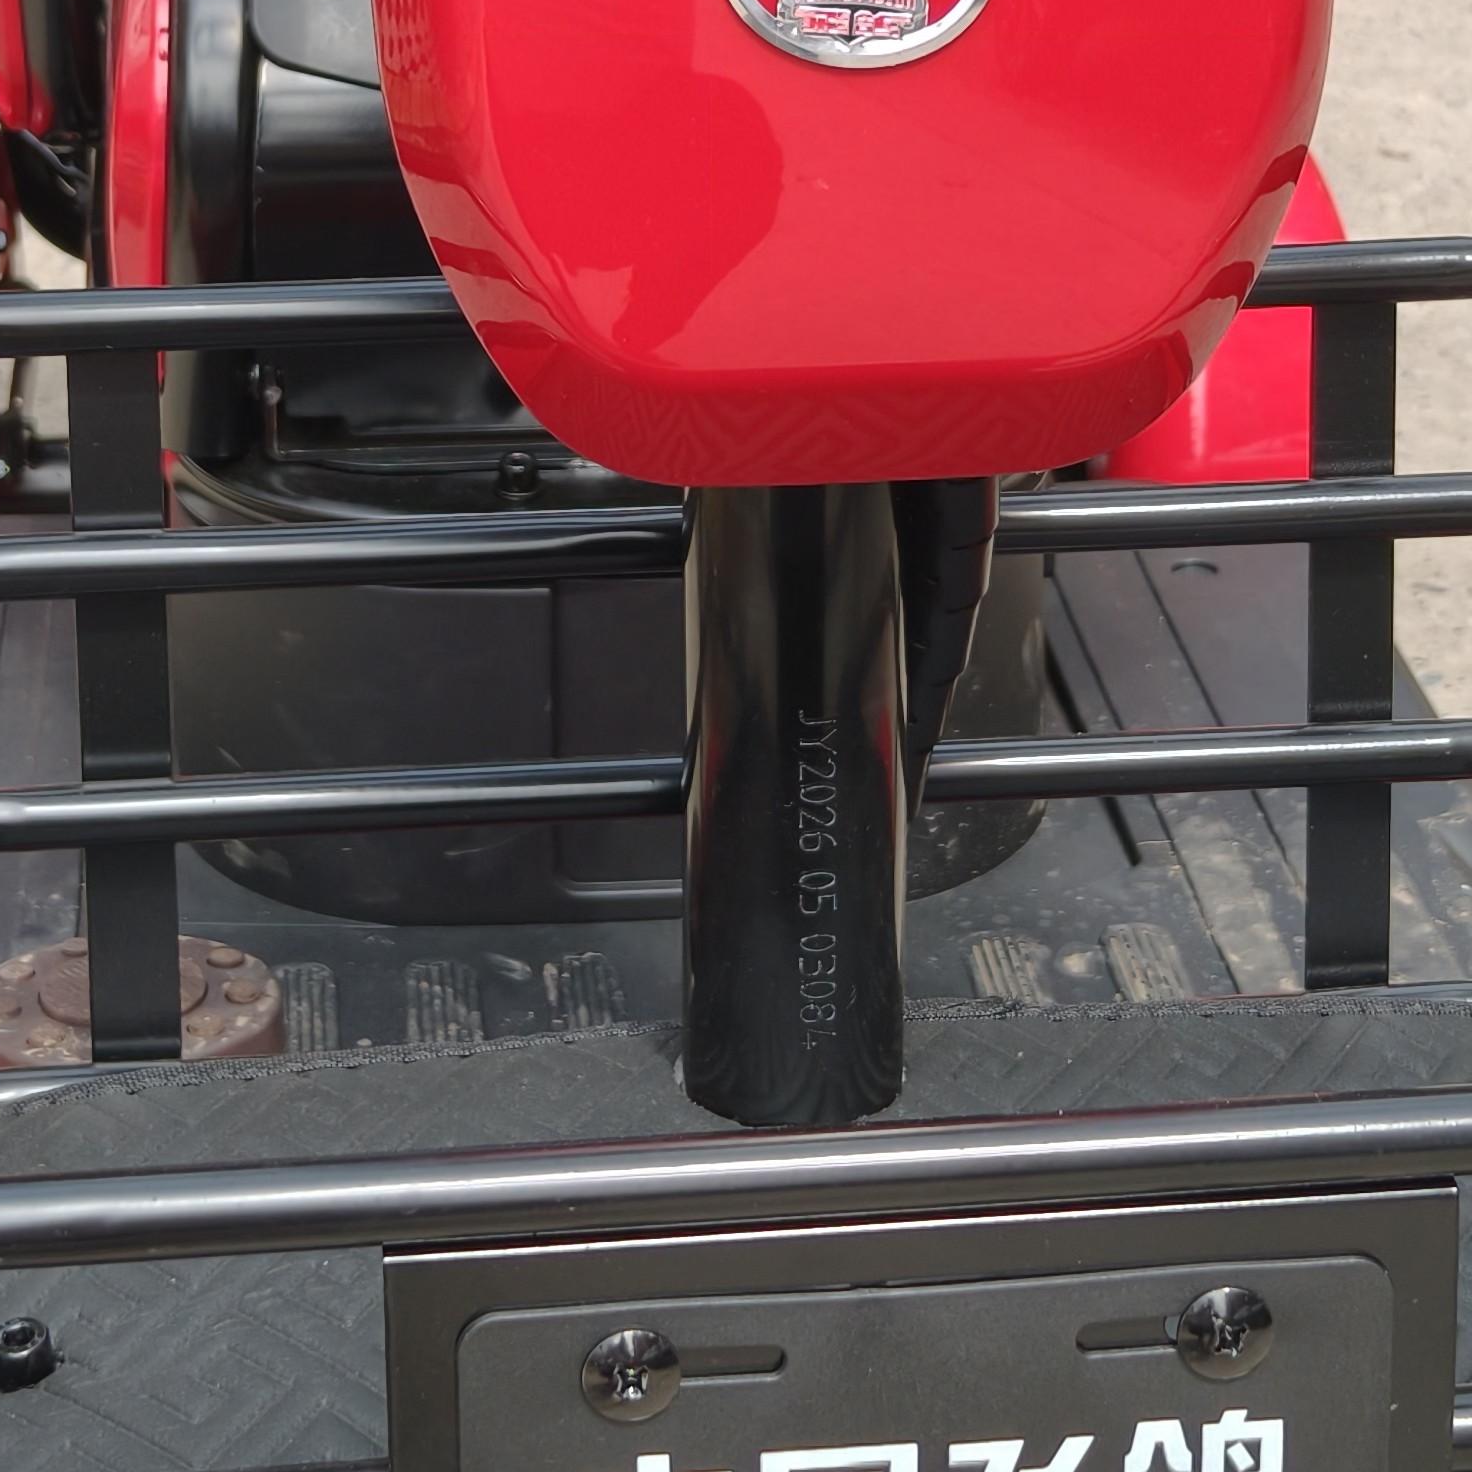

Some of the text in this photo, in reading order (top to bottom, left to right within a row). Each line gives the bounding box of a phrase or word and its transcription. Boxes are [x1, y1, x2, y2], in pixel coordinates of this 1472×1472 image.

[797, 708, 839, 1051] JY2026 05 03084
